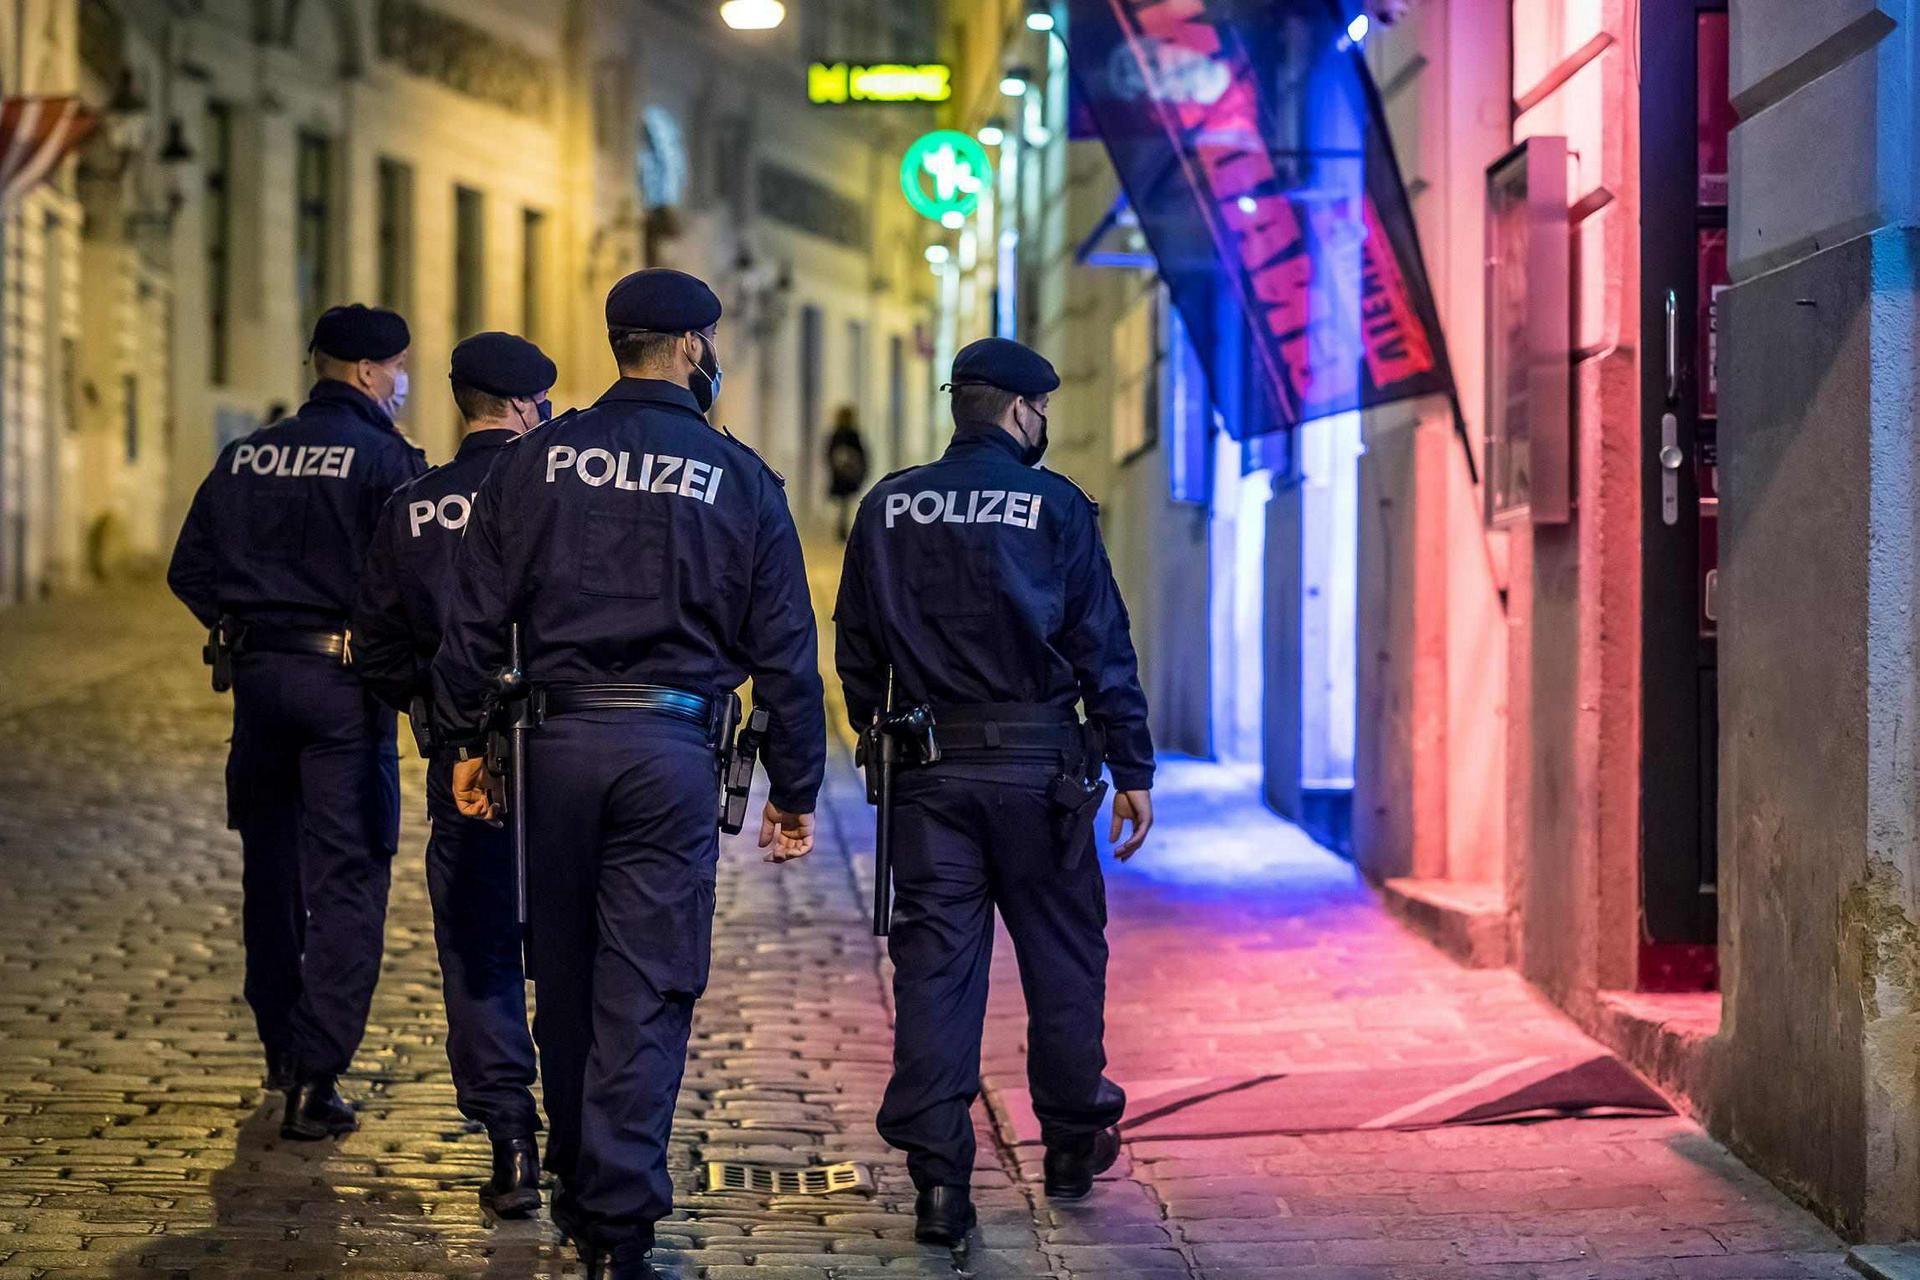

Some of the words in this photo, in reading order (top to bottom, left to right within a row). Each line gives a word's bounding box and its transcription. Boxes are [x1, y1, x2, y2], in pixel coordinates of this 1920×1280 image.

[231, 444, 355, 479] POLIZEI
[546, 445, 723, 505] POLIZEI
[409, 492, 478, 540] PO
[885, 490, 1042, 530] POLIZEI
